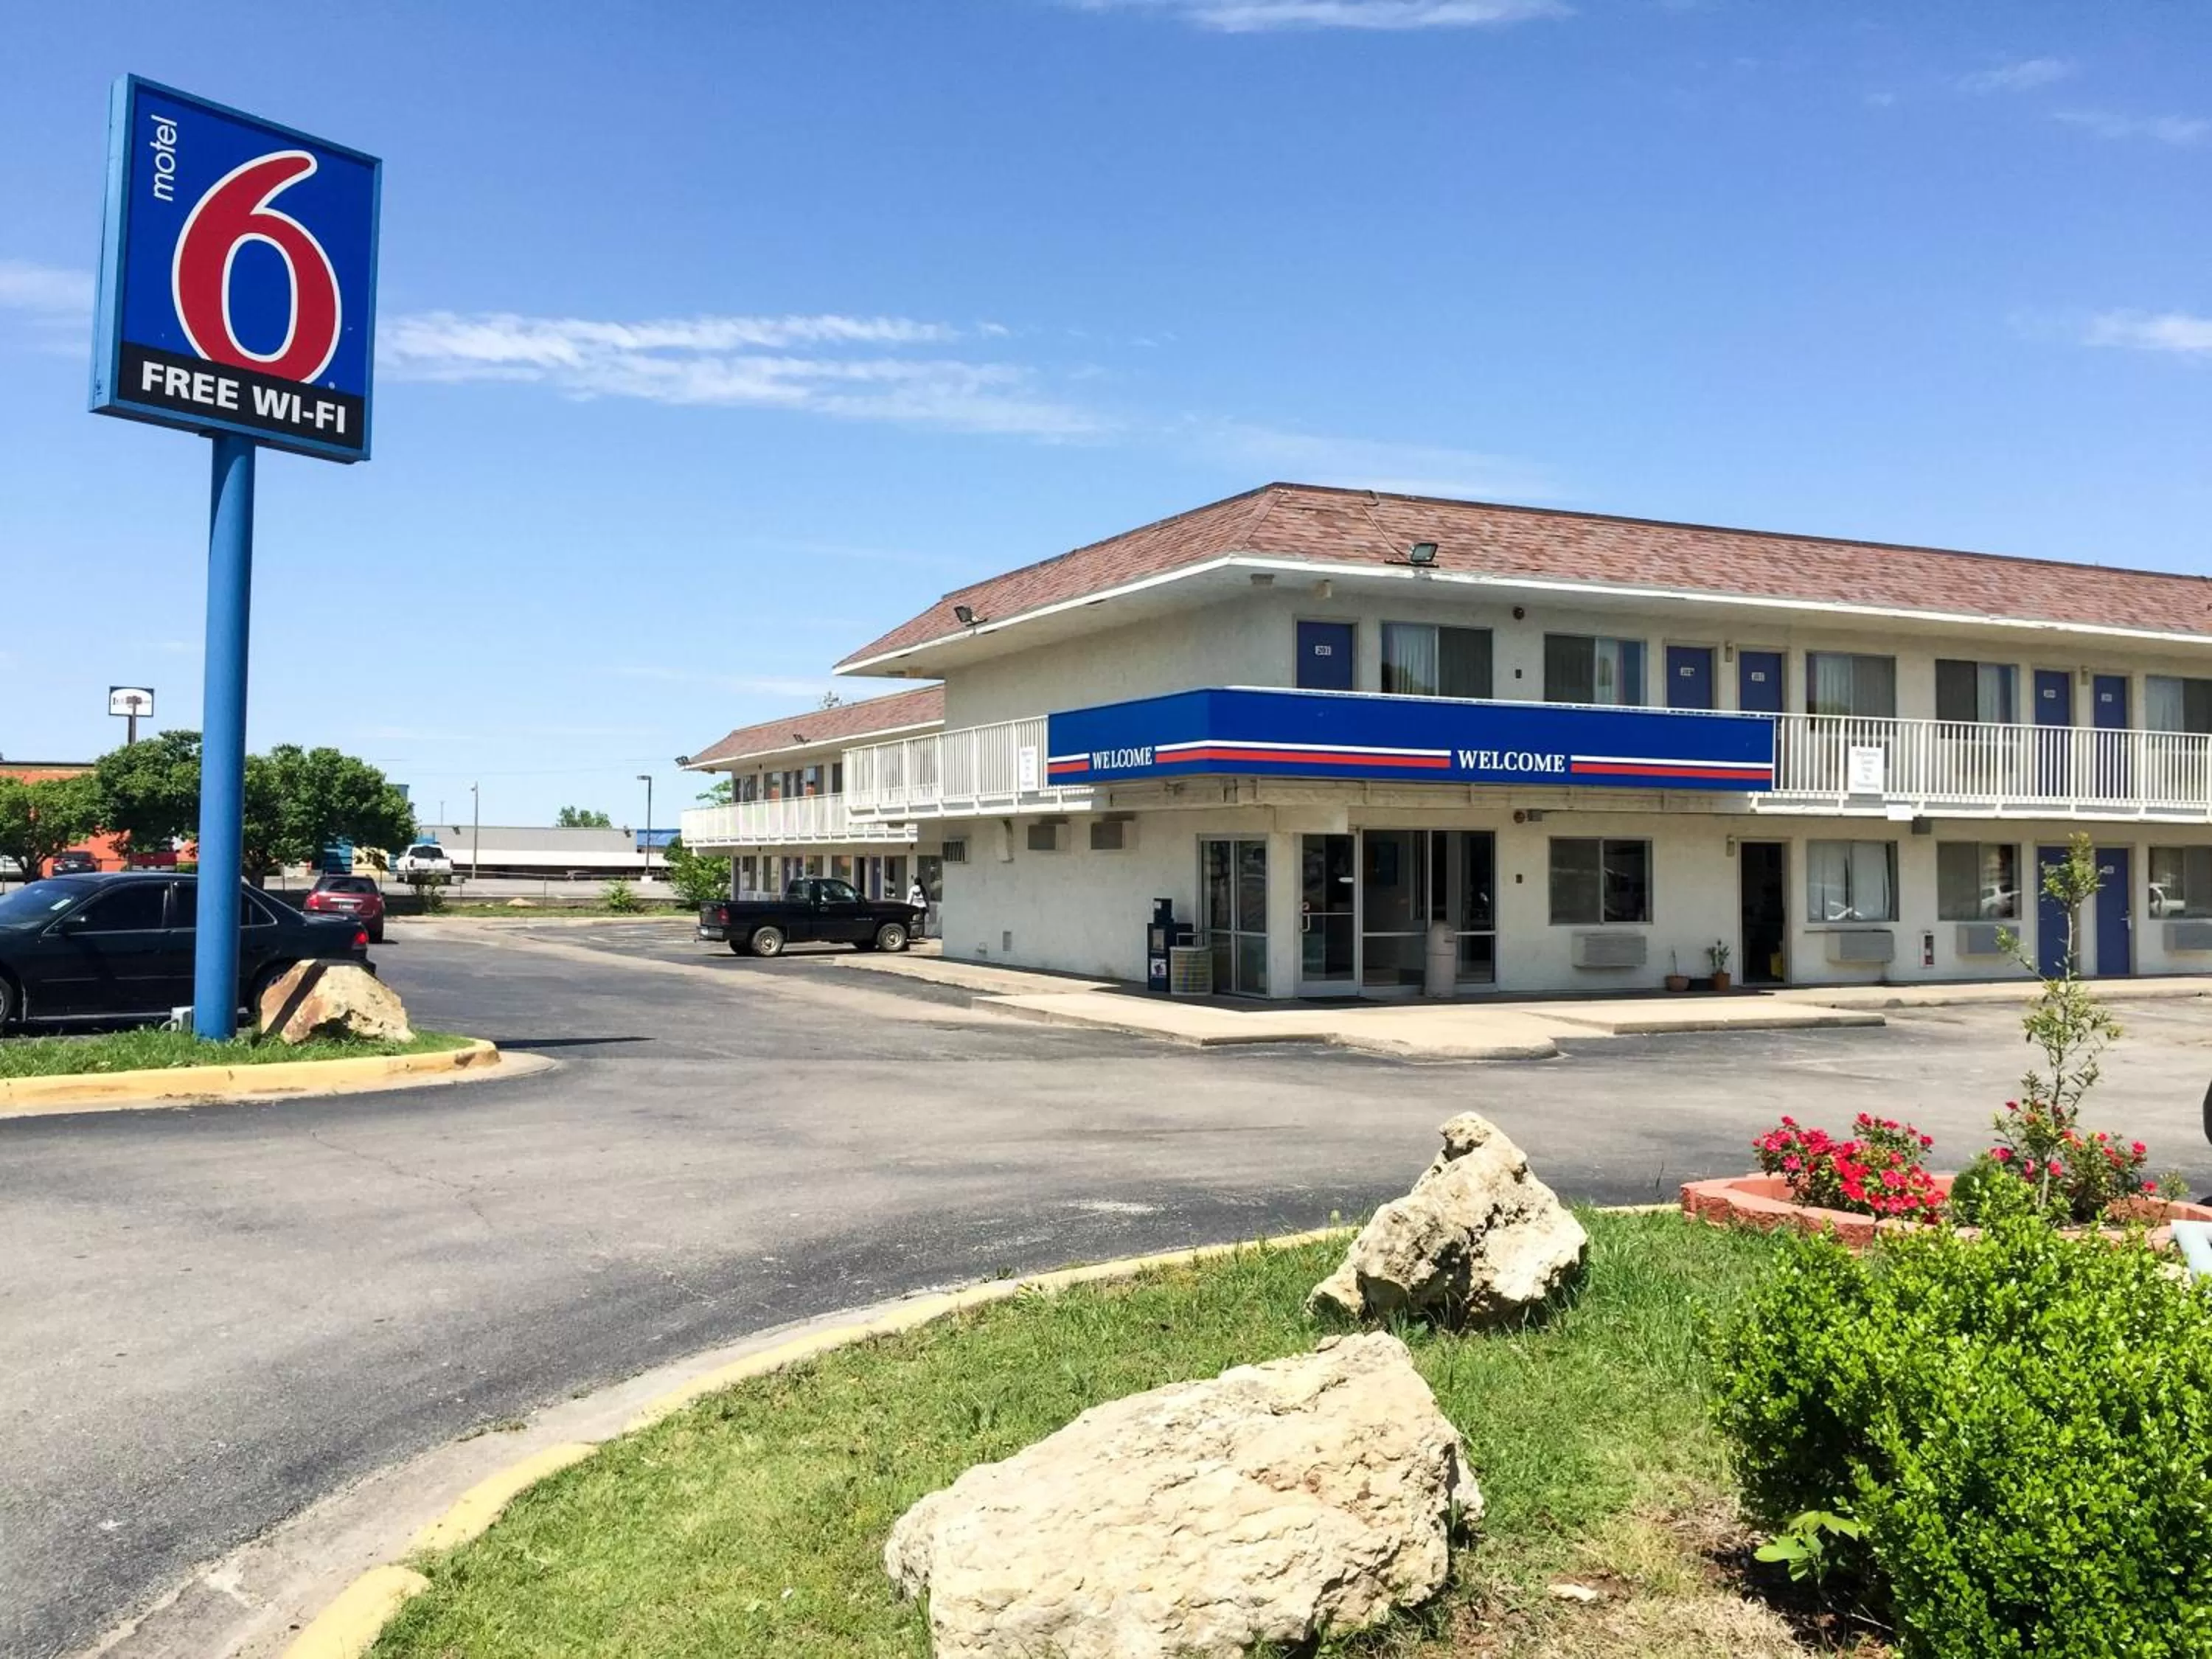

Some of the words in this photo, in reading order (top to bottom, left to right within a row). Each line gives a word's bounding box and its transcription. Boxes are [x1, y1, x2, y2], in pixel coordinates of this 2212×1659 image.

[151, 114, 178, 201] motel
[172, 150, 342, 384] 6
[142, 360, 239, 411] FREE
[253, 385, 346, 434] WI-FI
[1092, 746, 1153, 771] WELCOME
[1457, 750, 1566, 773] WELCOME
